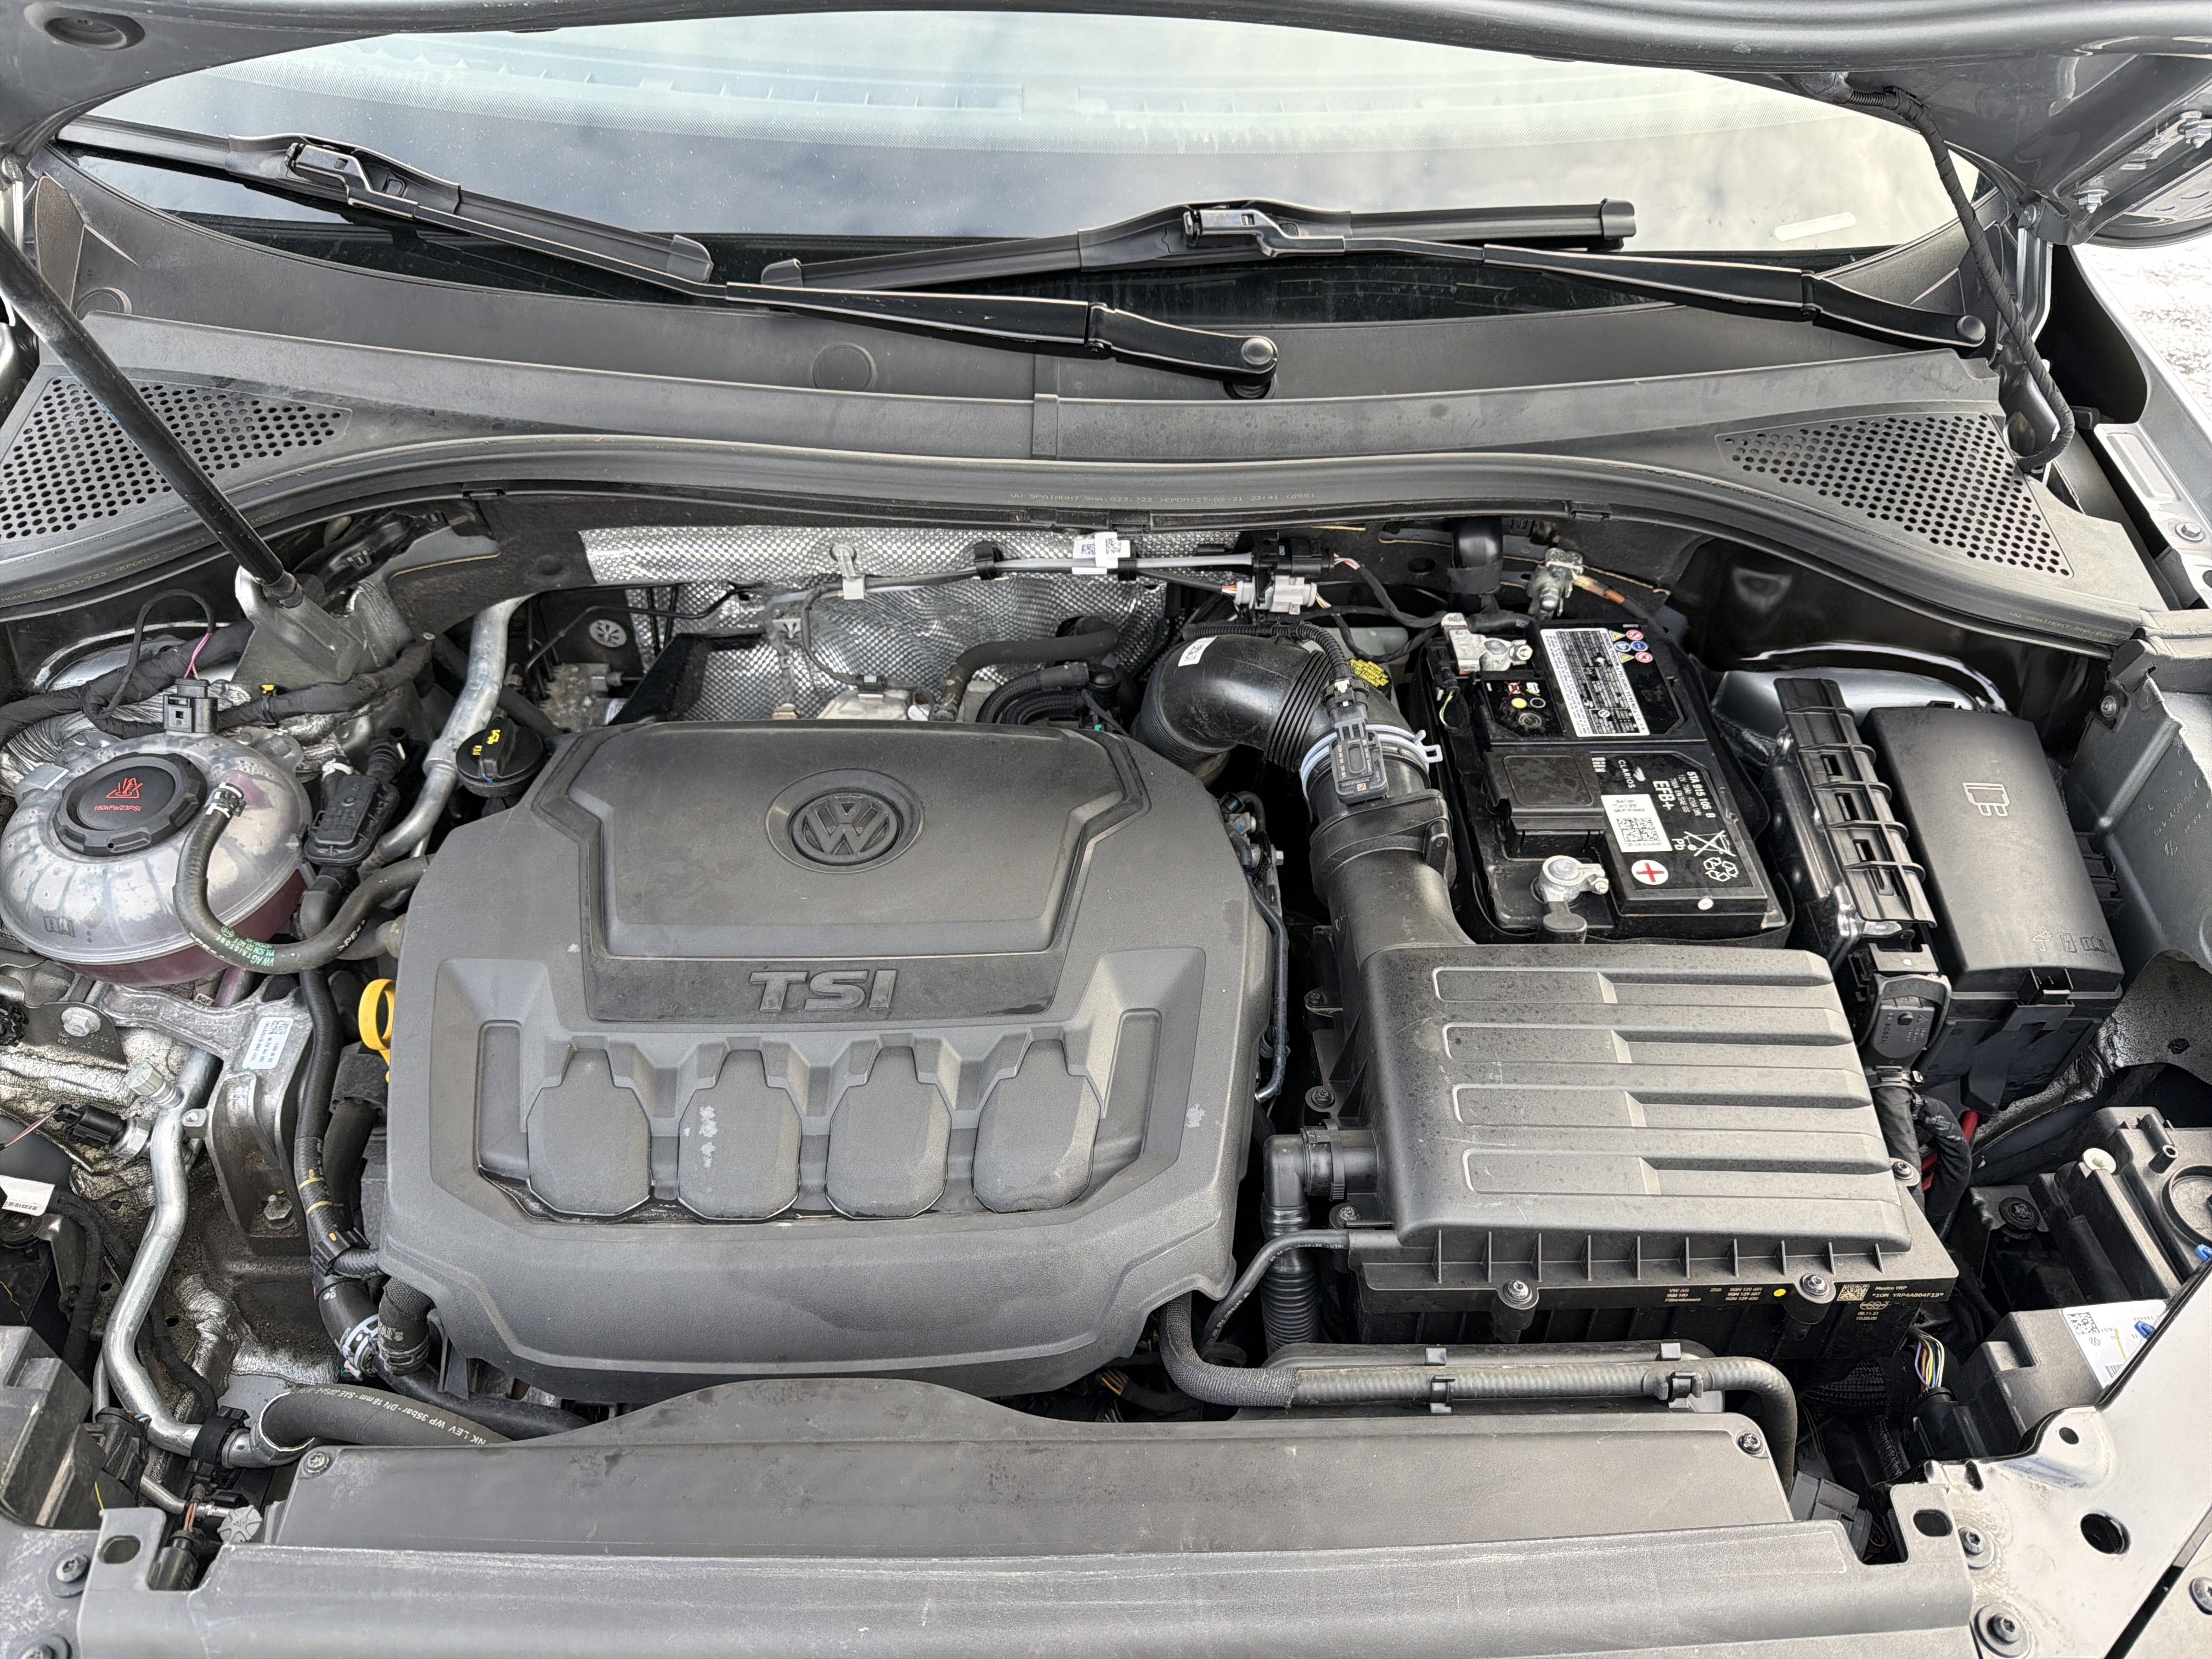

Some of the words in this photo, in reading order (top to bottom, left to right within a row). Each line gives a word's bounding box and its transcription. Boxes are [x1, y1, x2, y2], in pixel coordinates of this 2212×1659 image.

[1617, 759, 1637, 789] CLARIOS
[1686, 771, 1701, 783] 5TA
[1652, 781, 1676, 810] EFB+
[1692, 783, 1707, 797] 915
[1699, 798, 1712, 810] 105
[1671, 838, 1686, 850] Pb
[749, 969, 898, 1013] TSI
[402, 1407, 430, 1422] 35bar
[428, 1418, 447, 1430] WP
[448, 1425, 470, 1440] LEV
